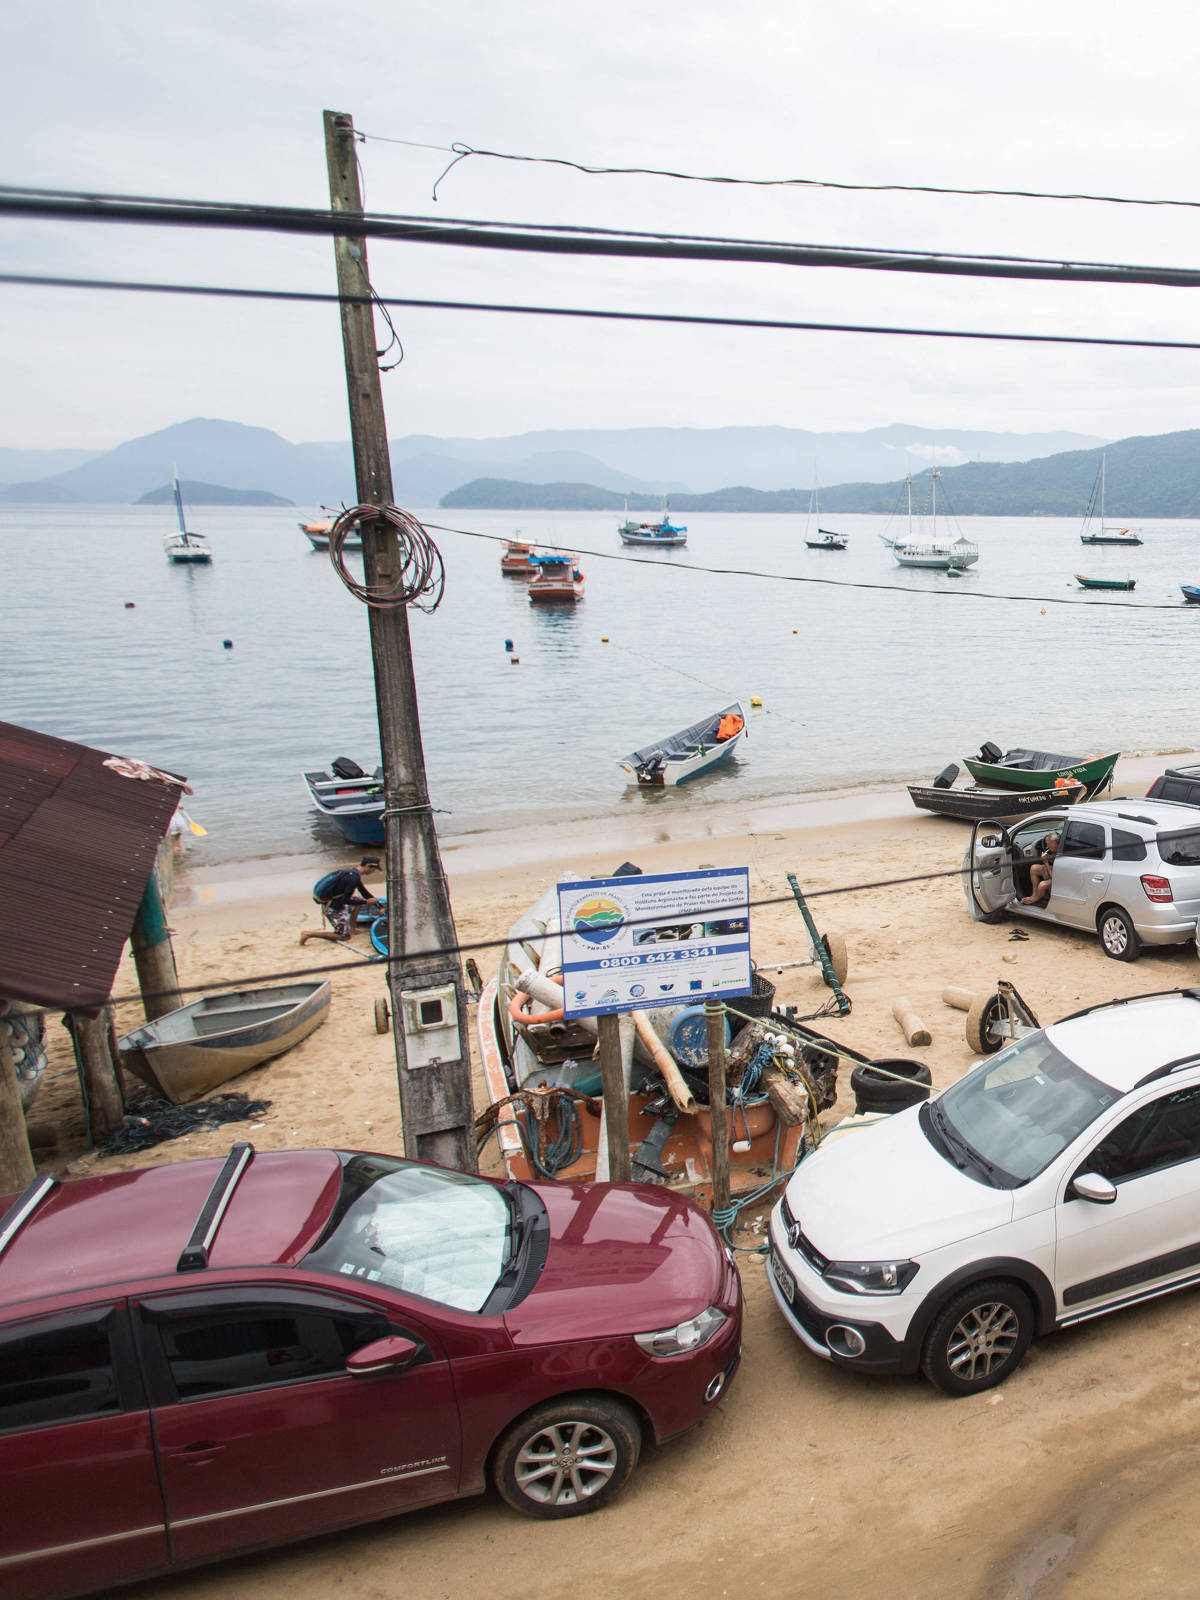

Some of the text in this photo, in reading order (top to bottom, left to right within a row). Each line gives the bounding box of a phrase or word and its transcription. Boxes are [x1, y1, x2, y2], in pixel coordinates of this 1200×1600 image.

[1073, 766, 1088, 774] VIDA
[600, 956, 641, 968] 0800
[645, 952, 675, 963] 642
[680, 947, 718, 959] 3341
[380, 1455, 447, 1474] COMFORTLINE
